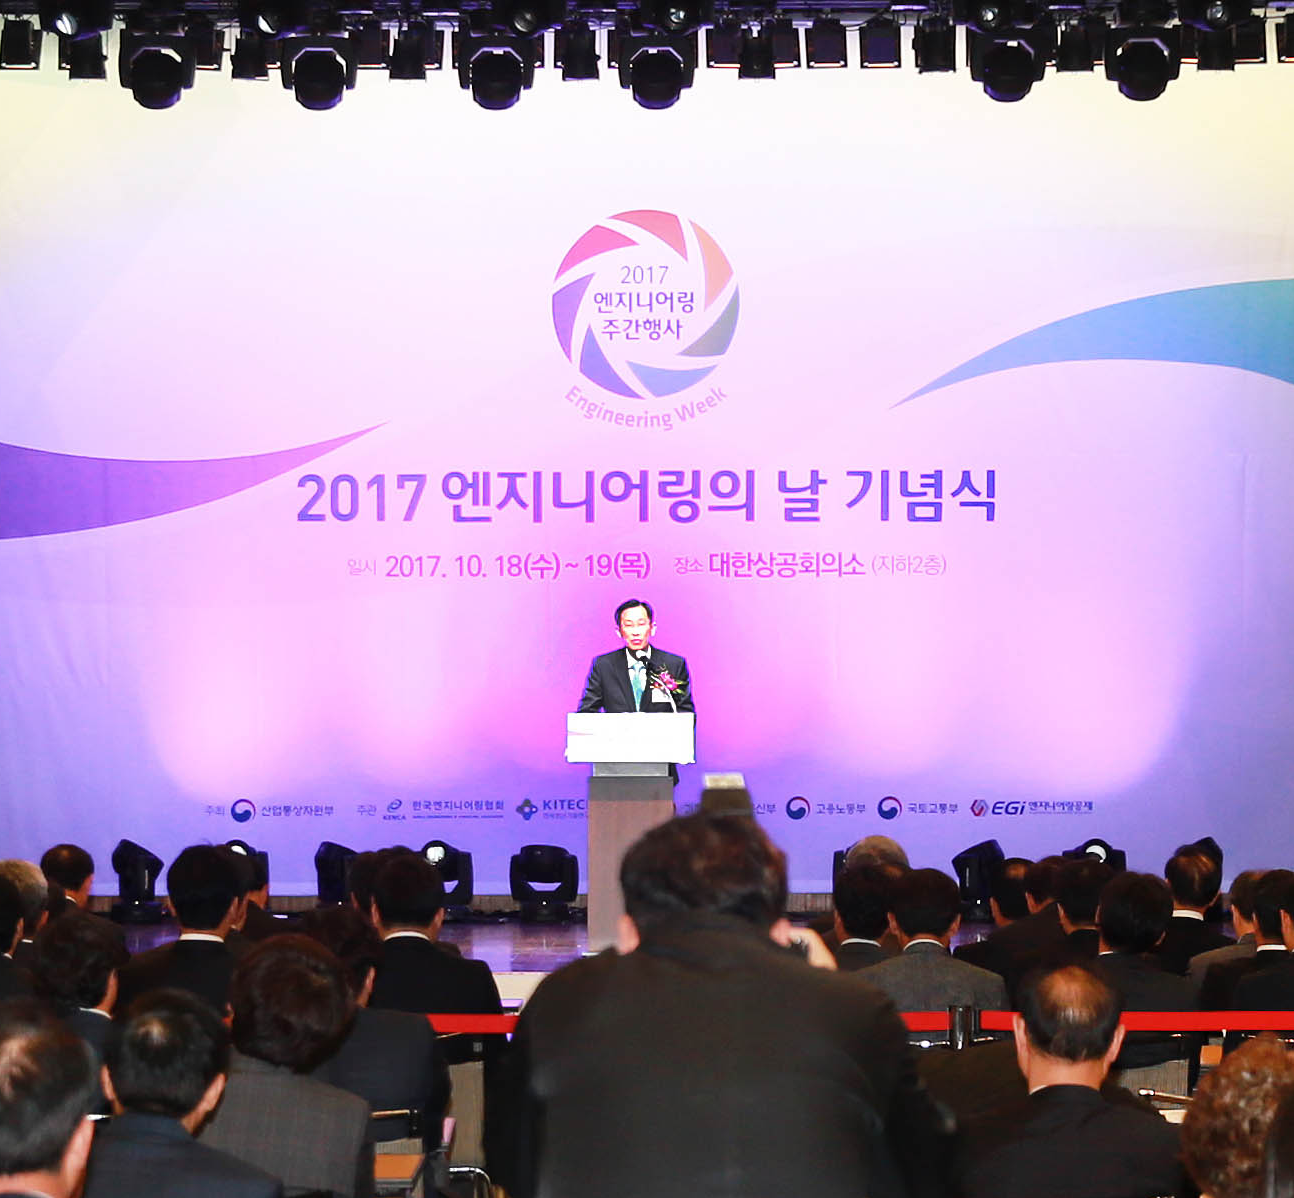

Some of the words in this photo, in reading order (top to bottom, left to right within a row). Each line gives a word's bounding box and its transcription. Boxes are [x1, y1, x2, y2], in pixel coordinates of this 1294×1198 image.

[619, 264, 670, 285] 2017
[592, 289, 697, 314] 엔지니어링
[600, 317, 685, 342] 주간행사
[564, 384, 674, 432] Engineering
[675, 385, 728, 424] Week
[296, 472, 427, 523] 2017
[441, 469, 756, 525] 엔지니어링의
[778, 470, 829, 524] 날
[845, 468, 998, 524] 기념식
[347, 558, 378, 576] 일시
[385, 553, 447, 578] 2017.
[454, 553, 488, 578] 10.
[674, 556, 704, 576] 장소
[708, 551, 866, 579] 대한상공회의소
[870, 553, 948, 578] (지하2층)
[261, 804, 335, 818] 산업통상자원부
[412, 799, 505, 813] 한국엔지니어링협회
[542, 799, 589, 811] KITEC
[816, 803, 867, 815] 고용노동부
[907, 803, 960, 815] 국토교통부
